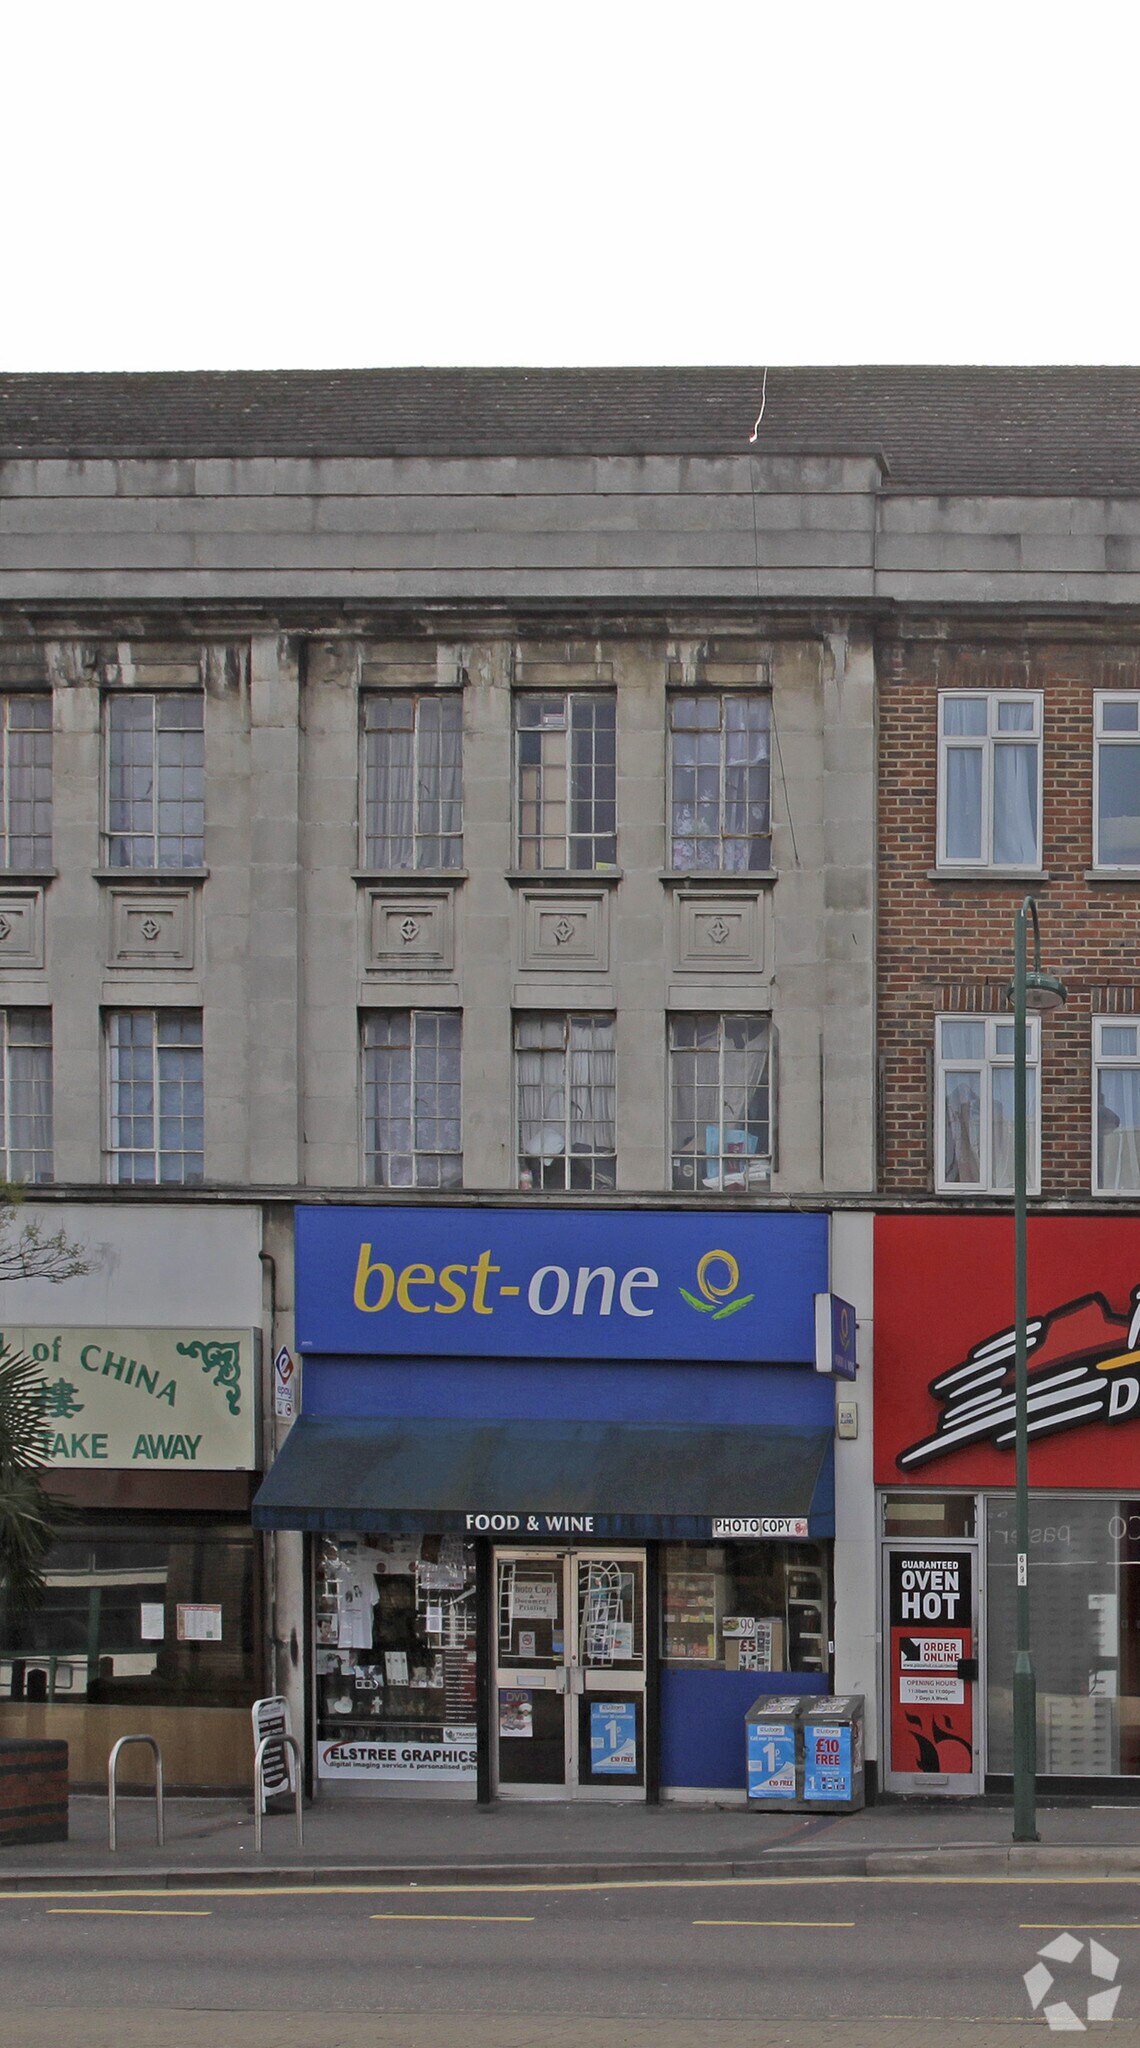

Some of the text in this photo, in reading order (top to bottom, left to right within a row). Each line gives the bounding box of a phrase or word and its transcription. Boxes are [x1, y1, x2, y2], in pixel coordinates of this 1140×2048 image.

[353, 1243, 659, 1317] best-one
[32, 1335, 62, 1362] of
[80, 1344, 178, 1407] CHINA
[37, 1433, 203, 1460] TAKE AWAY
[465, 1514, 595, 1533] FOOD & WINE
[714, 1519, 759, 1532] PHOTO
[762, 1520, 792, 1532] COPY
[901, 1560, 959, 1570] GUARANTEED
[901, 1570, 959, 1591] OVEN
[901, 1592, 960, 1620] HOT
[740, 1639, 756, 1652] £5
[924, 1642, 957, 1652] ORDER
[924, 1653, 960, 1662] ONLINE
[506, 1692, 529, 1702] DVD
[816, 1738, 840, 1753] £10
[330, 1748, 477, 1763] ELSTREE GRAPHICS
[816, 1754, 840, 1765] FREE
[330, 1760, 351, 1769] digital
[353, 1761, 380, 1770] imaging
[416, 1762, 460, 1770] personalised
[462, 1763, 477, 1771] gifts
